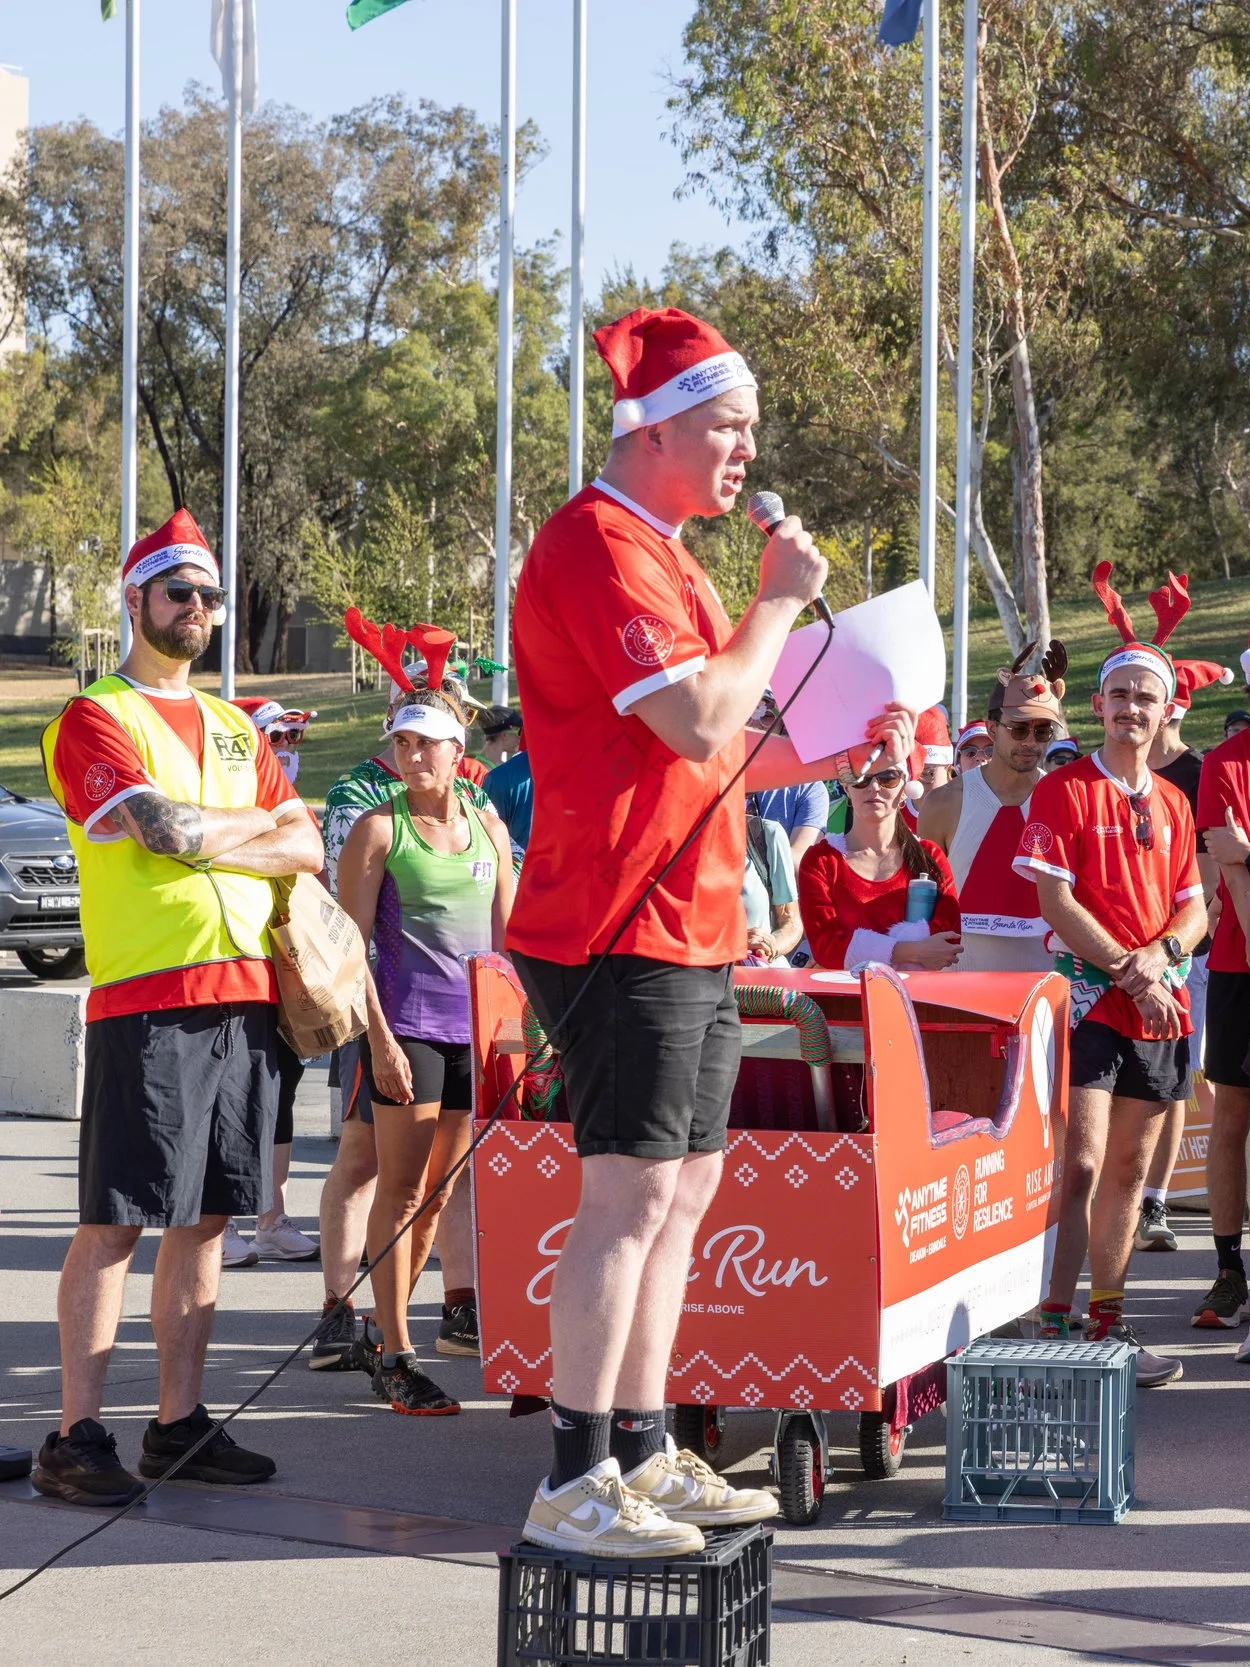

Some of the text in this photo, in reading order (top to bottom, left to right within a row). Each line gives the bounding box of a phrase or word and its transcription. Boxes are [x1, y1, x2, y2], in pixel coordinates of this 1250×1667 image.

[691, 362, 727, 381] ANYTIME
[693, 368, 731, 388] FITNESS
[172, 546, 204, 561] Santa
[990, 917, 1034, 931] Santa Run
[974, 1149, 1005, 1181] RUNNING
[911, 1176, 948, 1212] ANYTIME
[974, 1181, 988, 1207] FOR
[1026, 1167, 1042, 1197] RISE
[910, 1202, 948, 1238] FITNESS
[973, 1197, 1014, 1233] RESILIENCE
[703, 1224, 829, 1297] Run
[680, 1302, 745, 1315] RISE ABOVE
